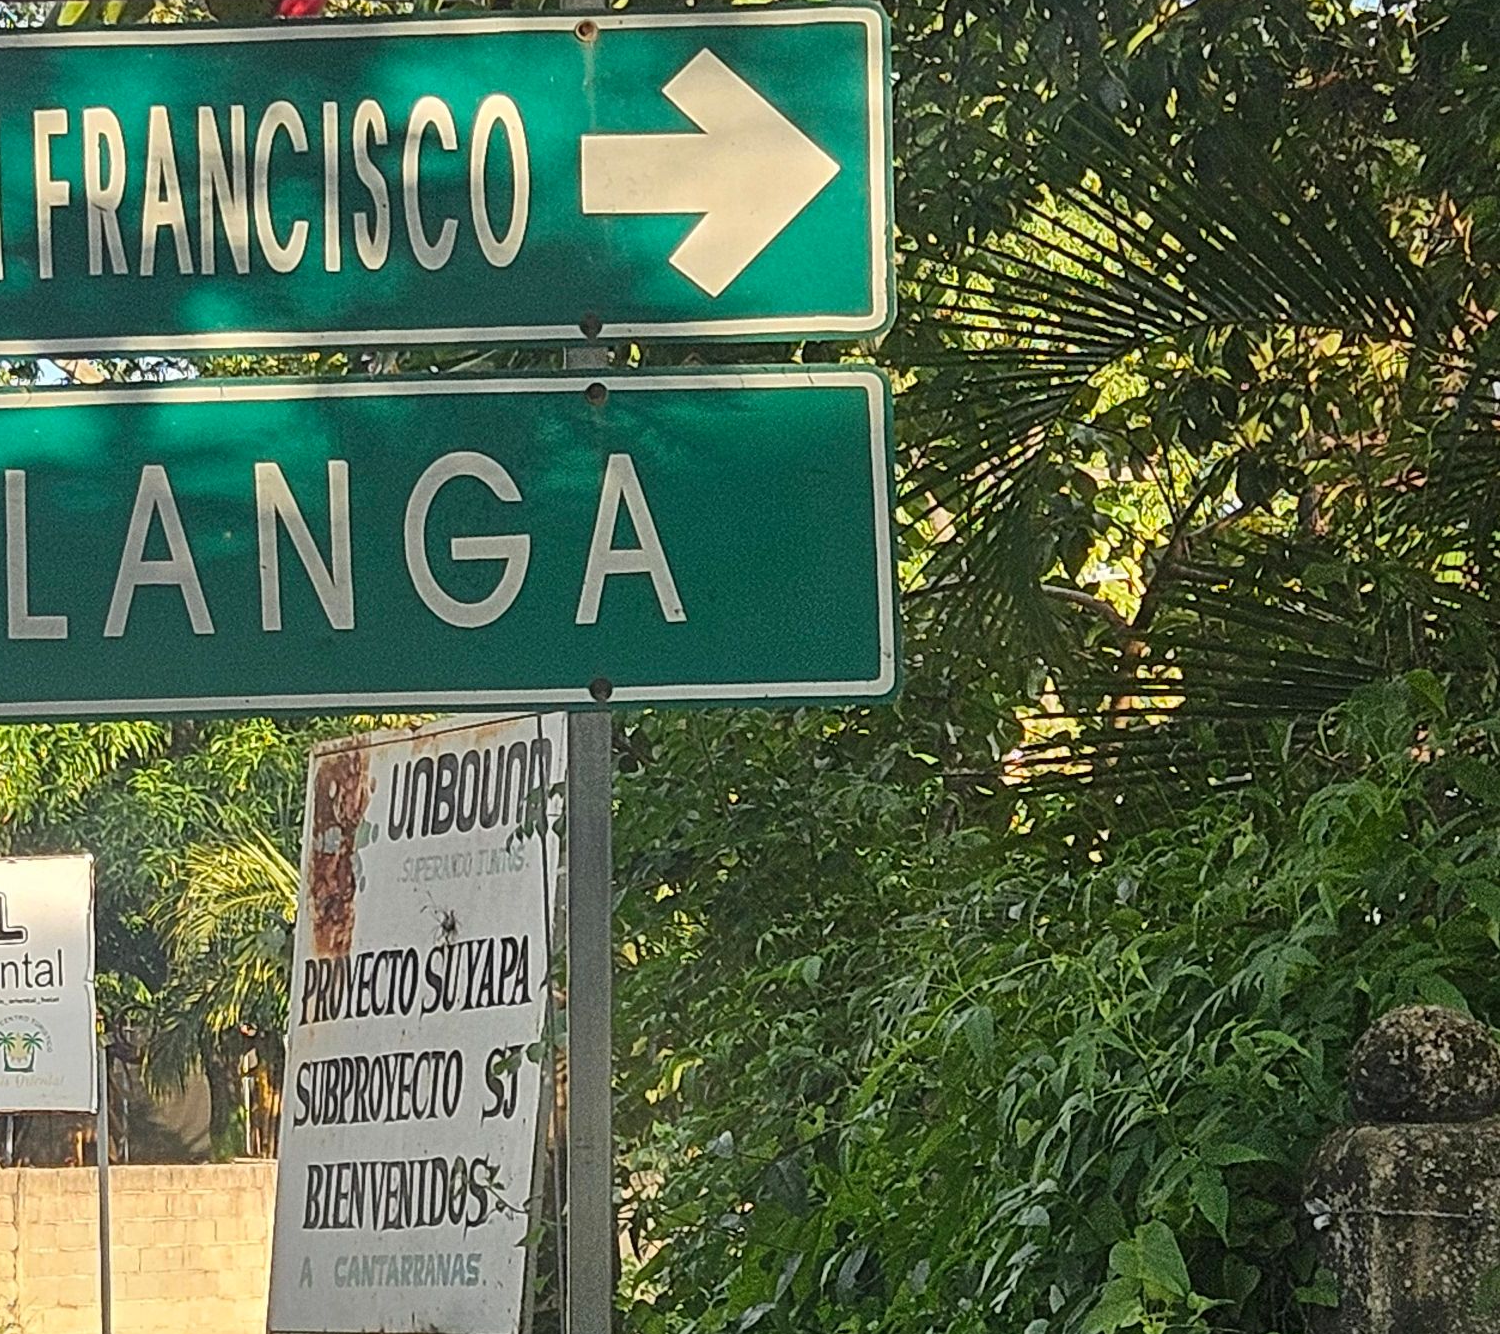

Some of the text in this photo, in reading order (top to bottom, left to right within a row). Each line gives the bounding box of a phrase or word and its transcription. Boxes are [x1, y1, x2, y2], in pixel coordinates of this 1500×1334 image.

[33, 93, 530, 280] FRANCISCO
[298, 934, 533, 1027] PROYECTO SUYAPA
[292, 1049, 464, 1129] SUBPROYECTO
[302, 1155, 490, 1234] BIENVENIDOS
[301, 1256, 313, 1289] A
